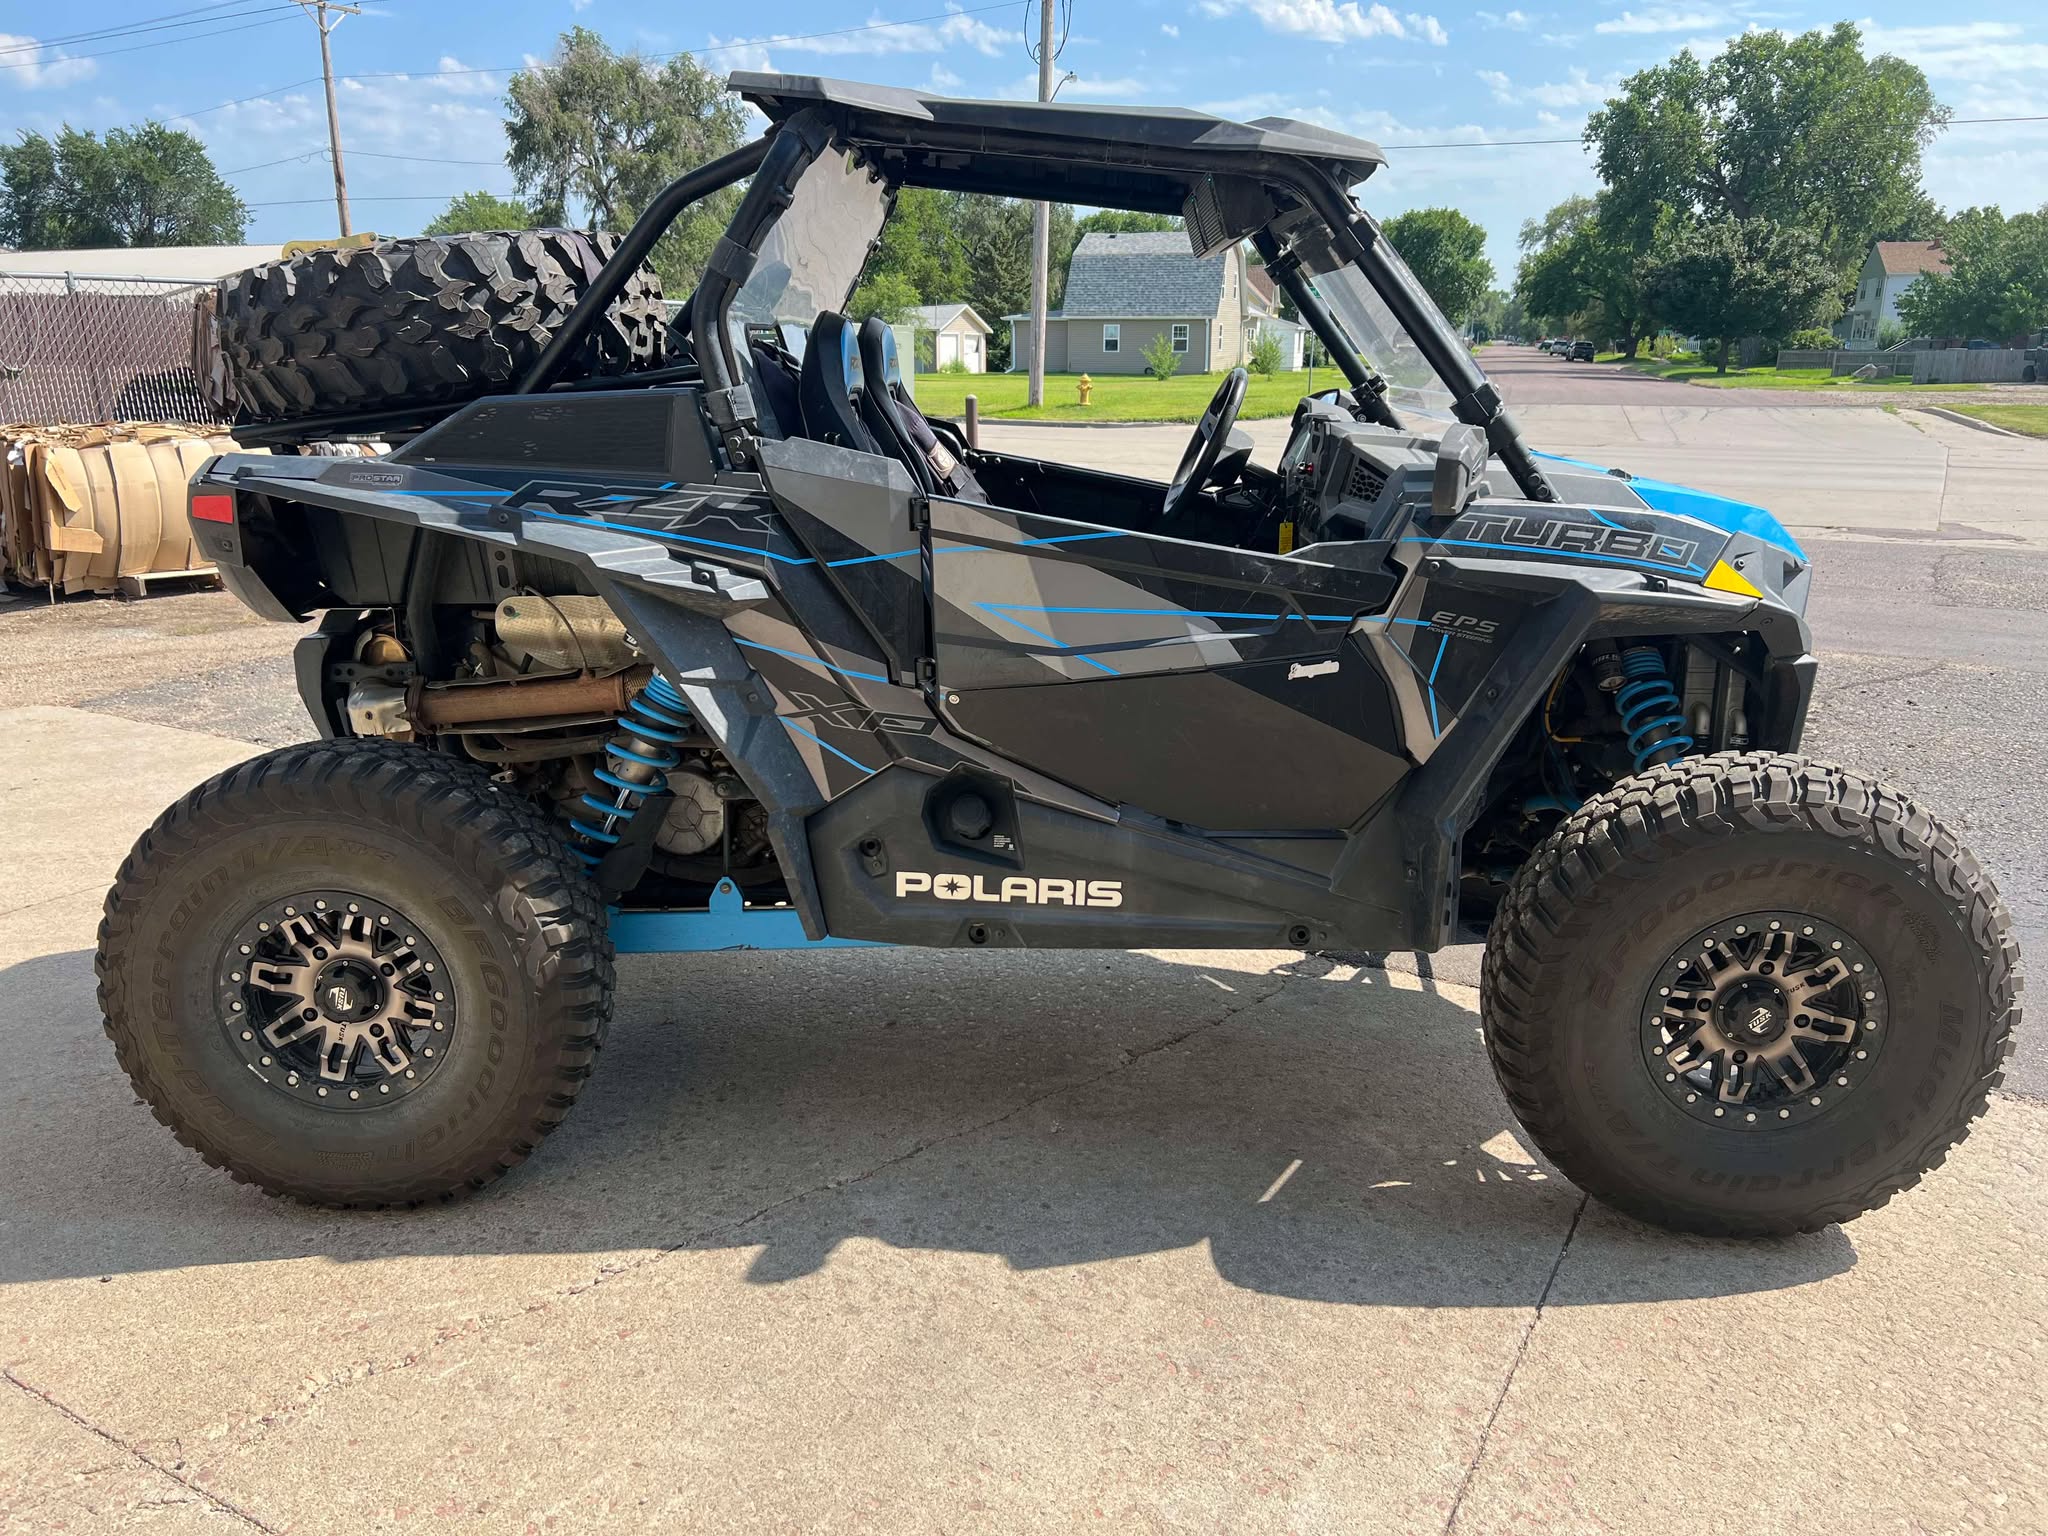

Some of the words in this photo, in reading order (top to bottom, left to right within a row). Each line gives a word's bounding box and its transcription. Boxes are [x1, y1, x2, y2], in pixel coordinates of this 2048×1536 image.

[351, 473, 403, 484] PROSTAR
[502, 479, 780, 536] RZR
[1456, 511, 1700, 569] TURBO
[1431, 611, 1500, 633] EPS
[895, 871, 1123, 908] POLARIS
[336, 986, 347, 1011] TUSK
[1785, 981, 1806, 995] TUSK
[1748, 1011, 1773, 1029] TUSK
[338, 1022, 347, 1041] TUSK
